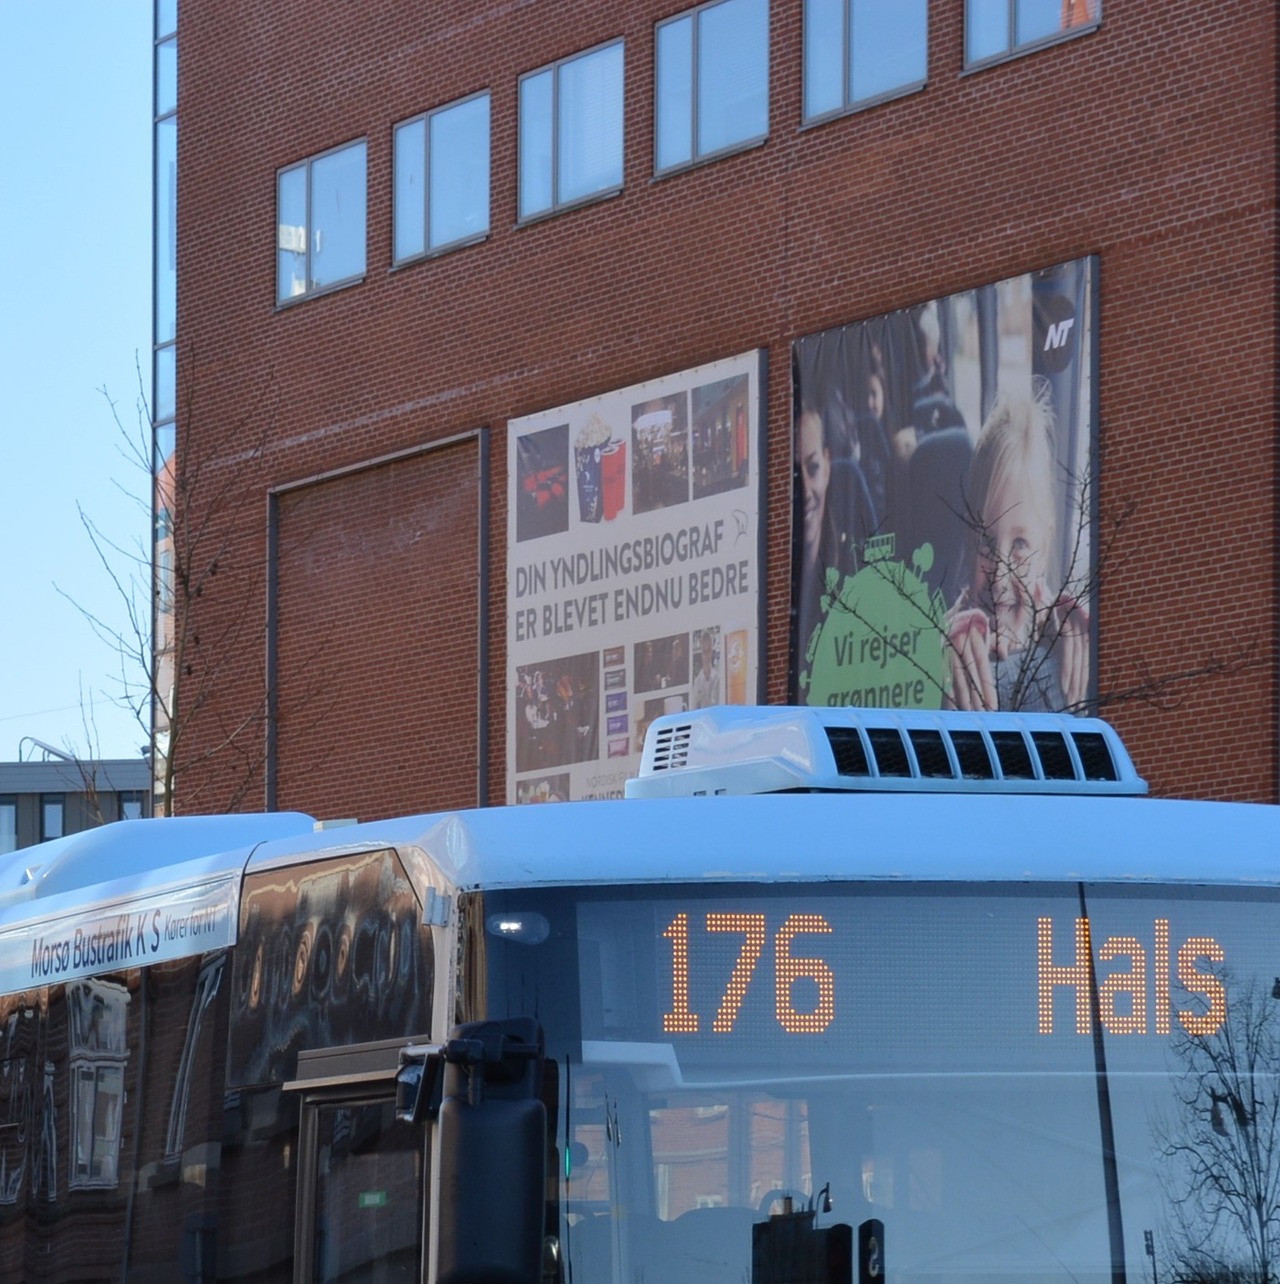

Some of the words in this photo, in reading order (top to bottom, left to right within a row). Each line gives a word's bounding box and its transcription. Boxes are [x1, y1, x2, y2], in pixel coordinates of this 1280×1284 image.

[1044, 317, 1074, 351] NT
[516, 560, 547, 599] DIN
[550, 519, 723, 589] YNDLINGSBIOGRAF
[515, 608, 538, 643] ER
[543, 591, 608, 635] BLEVET
[615, 577, 684, 621] ENDNU
[688, 559, 750, 605] BEDRE
[834, 631, 854, 667] Vi
[860, 625, 922, 669] rejser
[31, 938, 70, 978] Morsø
[73, 913, 133, 969] Bustrafik
[663, 913, 834, 1033] 176
[1037, 916, 1226, 1036] Hals
